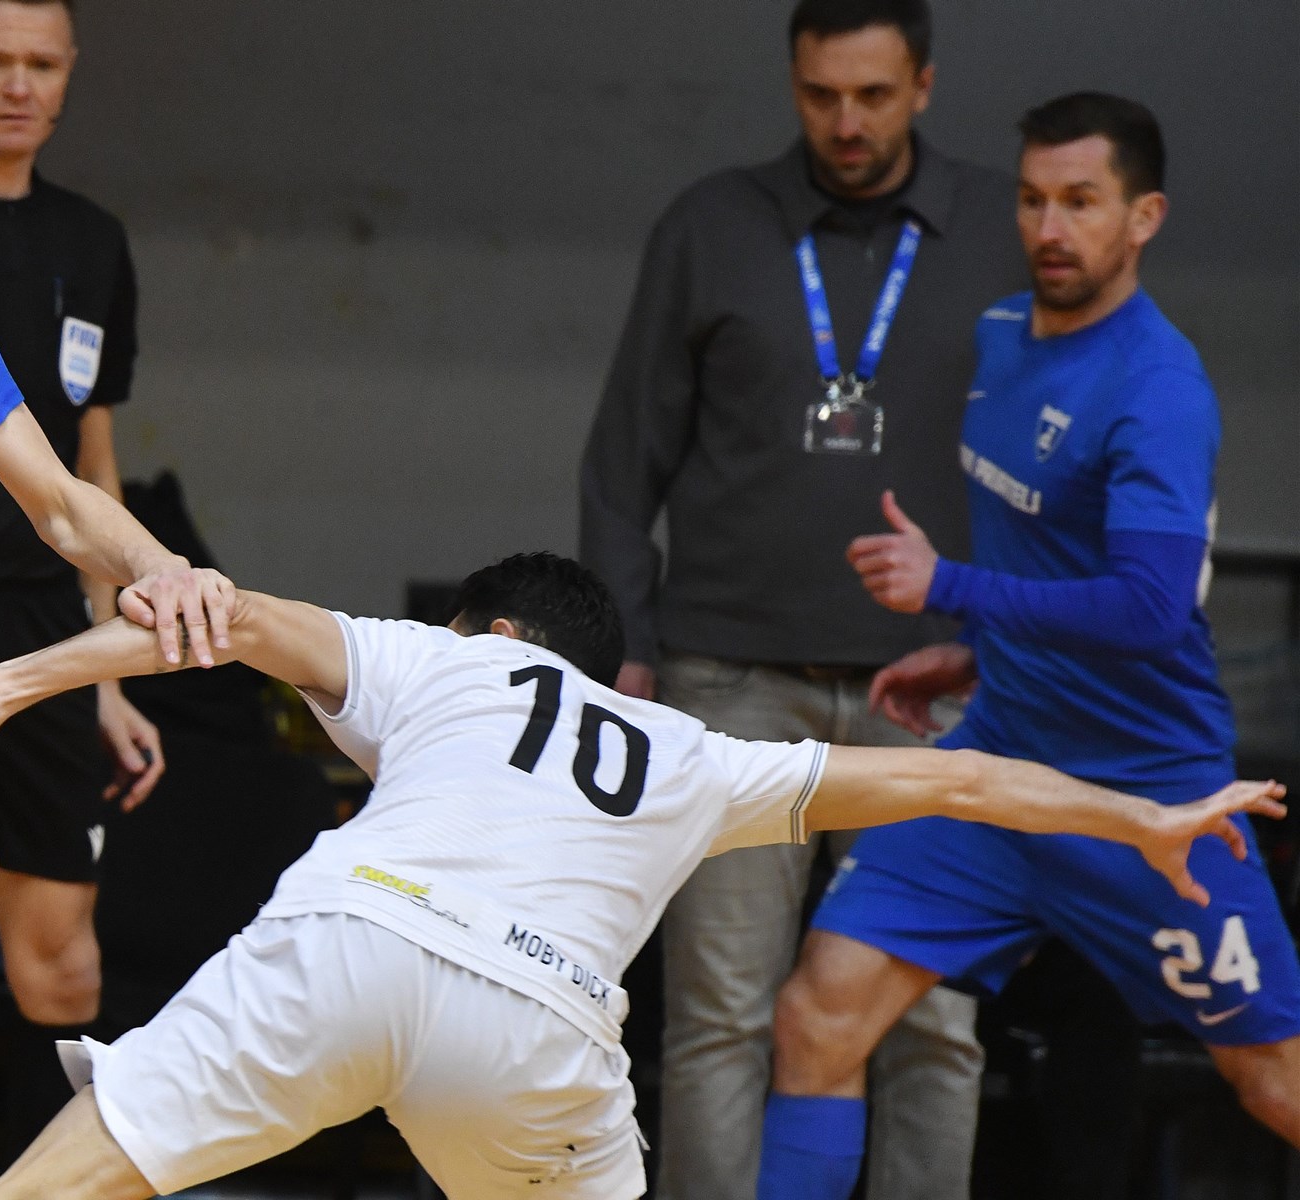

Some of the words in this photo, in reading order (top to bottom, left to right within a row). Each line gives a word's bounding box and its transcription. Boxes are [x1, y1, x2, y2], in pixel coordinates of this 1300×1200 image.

[508, 664, 651, 817] 10
[503, 922, 566, 973] MOBY
[571, 963, 611, 1011] DICK
[1151, 914, 1261, 999] 24
